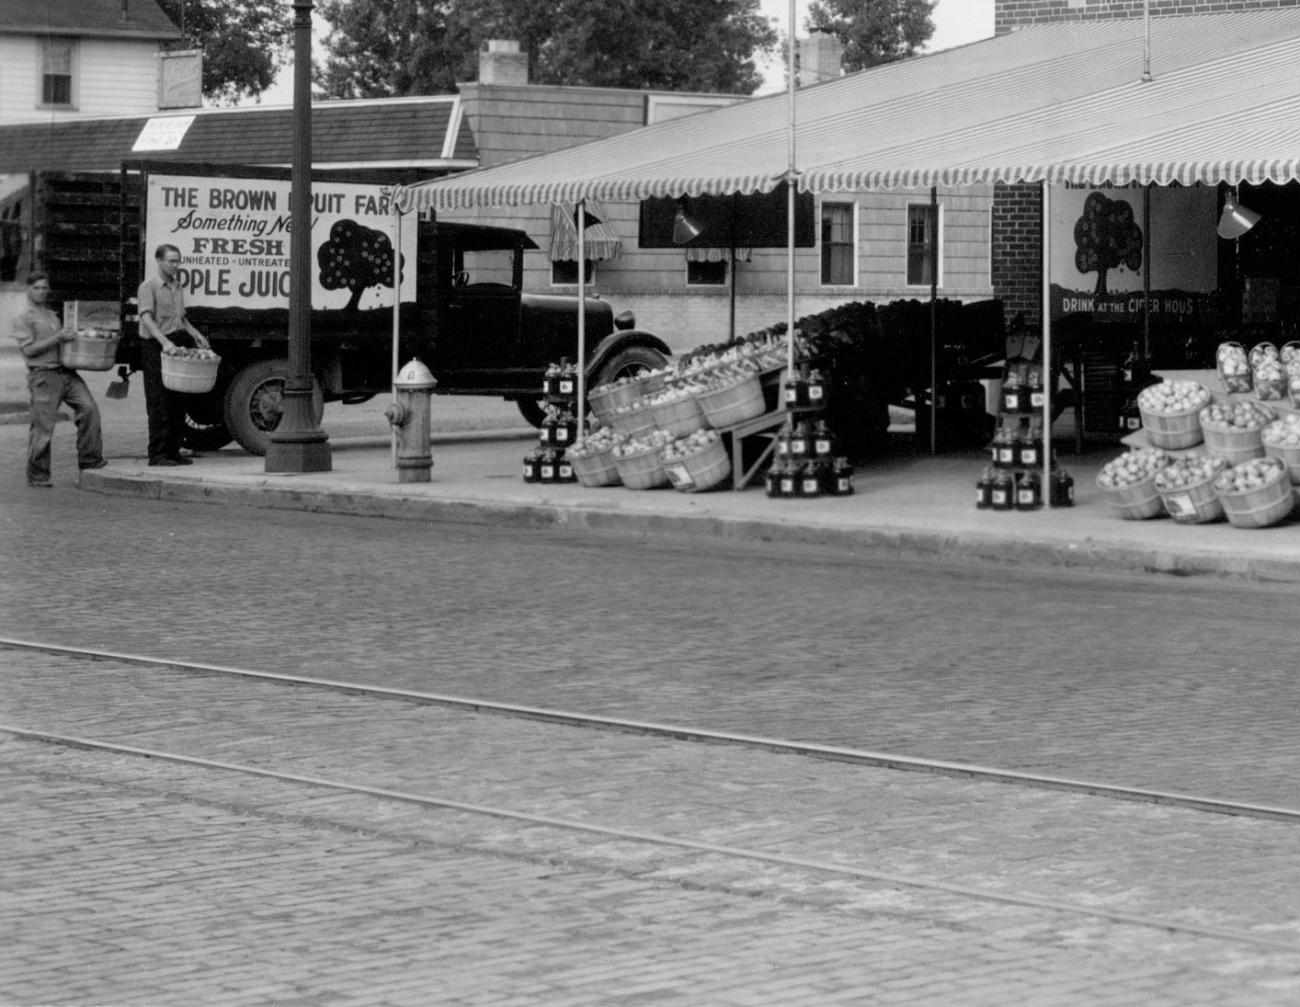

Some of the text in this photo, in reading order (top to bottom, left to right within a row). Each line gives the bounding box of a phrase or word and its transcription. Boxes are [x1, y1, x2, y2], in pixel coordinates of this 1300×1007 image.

[160, 187, 199, 209] THE
[209, 189, 277, 212] BROWN
[355, 195, 391, 216] FAR
[171, 210, 267, 237] Something
[192, 237, 285, 256] FRESH
[238, 257, 291, 268] UNTREATE
[176, 268, 291, 298] PPLE JUIC
[1062, 297, 1095, 313] DRINK
[1097, 302, 1107, 313] AT
[1109, 302, 1126, 313] THE
[1165, 298, 1201, 314] HOUS
